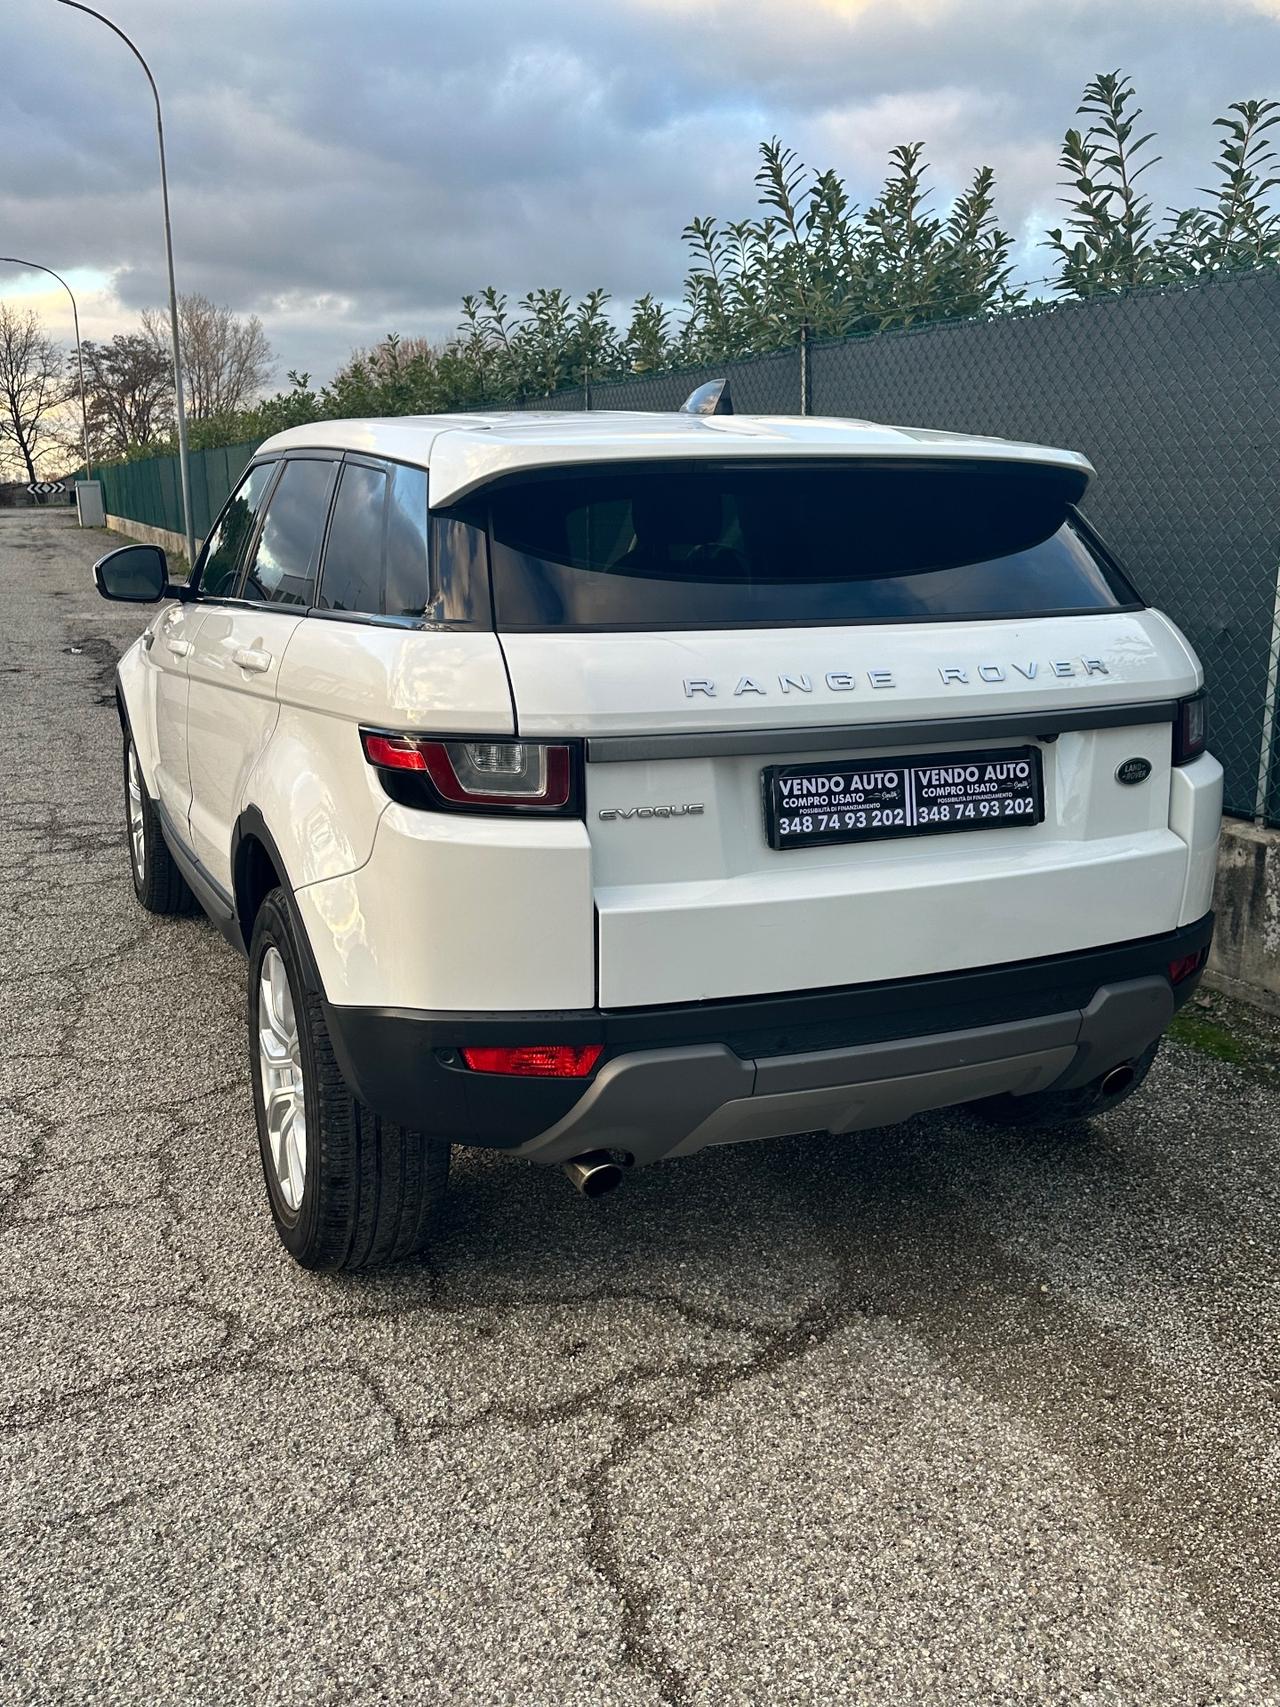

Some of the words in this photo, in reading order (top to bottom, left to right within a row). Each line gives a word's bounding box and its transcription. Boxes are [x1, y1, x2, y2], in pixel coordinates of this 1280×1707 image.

[682, 668, 897, 698] RANGE
[937, 655, 1110, 685] ROVER
[779, 776, 845, 795] VENDO
[850, 772, 898, 791] AUTO
[918, 767, 979, 786] VENDO
[984, 763, 1029, 781] AUTO
[922, 785, 964, 797] COMPRO
[967, 783, 998, 794] USATO
[972, 792, 1013, 800] FINANZIAMENTO
[783, 796, 829, 808] COMPRO
[831, 793, 864, 804] USATO
[838, 803, 881, 811] FINANZIAMENTO
[918, 805, 950, 823] 348
[954, 803, 975, 819] 74
[979, 801, 1000, 817] 93
[1004, 797, 1034, 815] 202
[599, 804, 704, 821] EVOQUE
[779, 816, 813, 834] 348
[818, 814, 841, 831] 74
[844, 812, 866, 829] 93
[871, 809, 904, 826] 202
